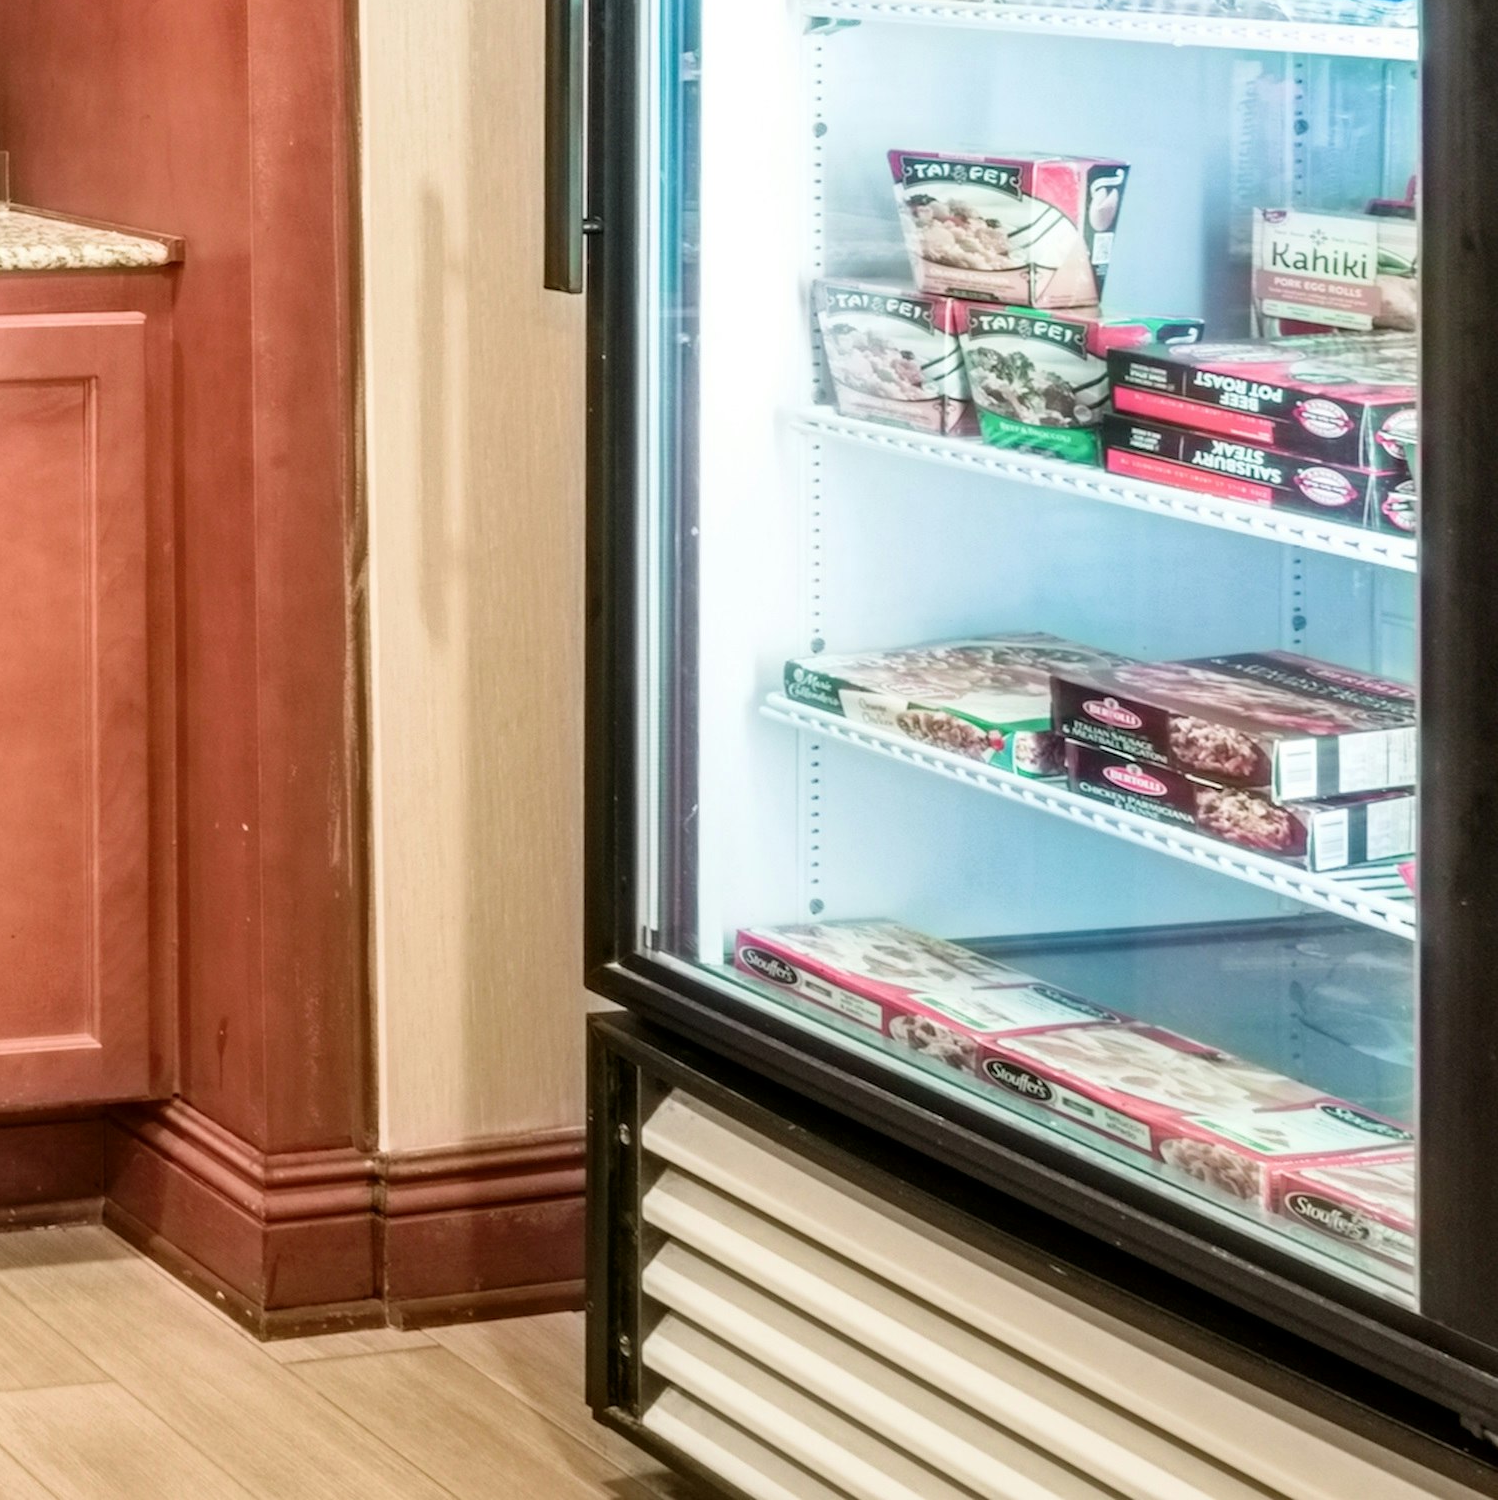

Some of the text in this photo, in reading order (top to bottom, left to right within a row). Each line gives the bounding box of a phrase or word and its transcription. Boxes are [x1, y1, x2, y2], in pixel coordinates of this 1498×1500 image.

[913, 162, 1009, 186] TAI PEI
[1270, 240, 1369, 281] Kahiki
[1273, 276, 1363, 299] PORK EGG ROLLS
[836, 293, 922, 319] TAI PEI
[978, 315, 1075, 343] TAI PEI
[1192, 370, 1284, 404] POT ROAST
[1218, 390, 1260, 413] BEEF
[1211, 439, 1266, 467] STEAK
[1190, 450, 1283, 485] SALISBURY
[1088, 703, 1137, 727] BERTOLLI
[1109, 770, 1162, 792] BERTOLLI
[741, 946, 799, 986] Stouffer's
[990, 1059, 1049, 1099] Stouffer's
